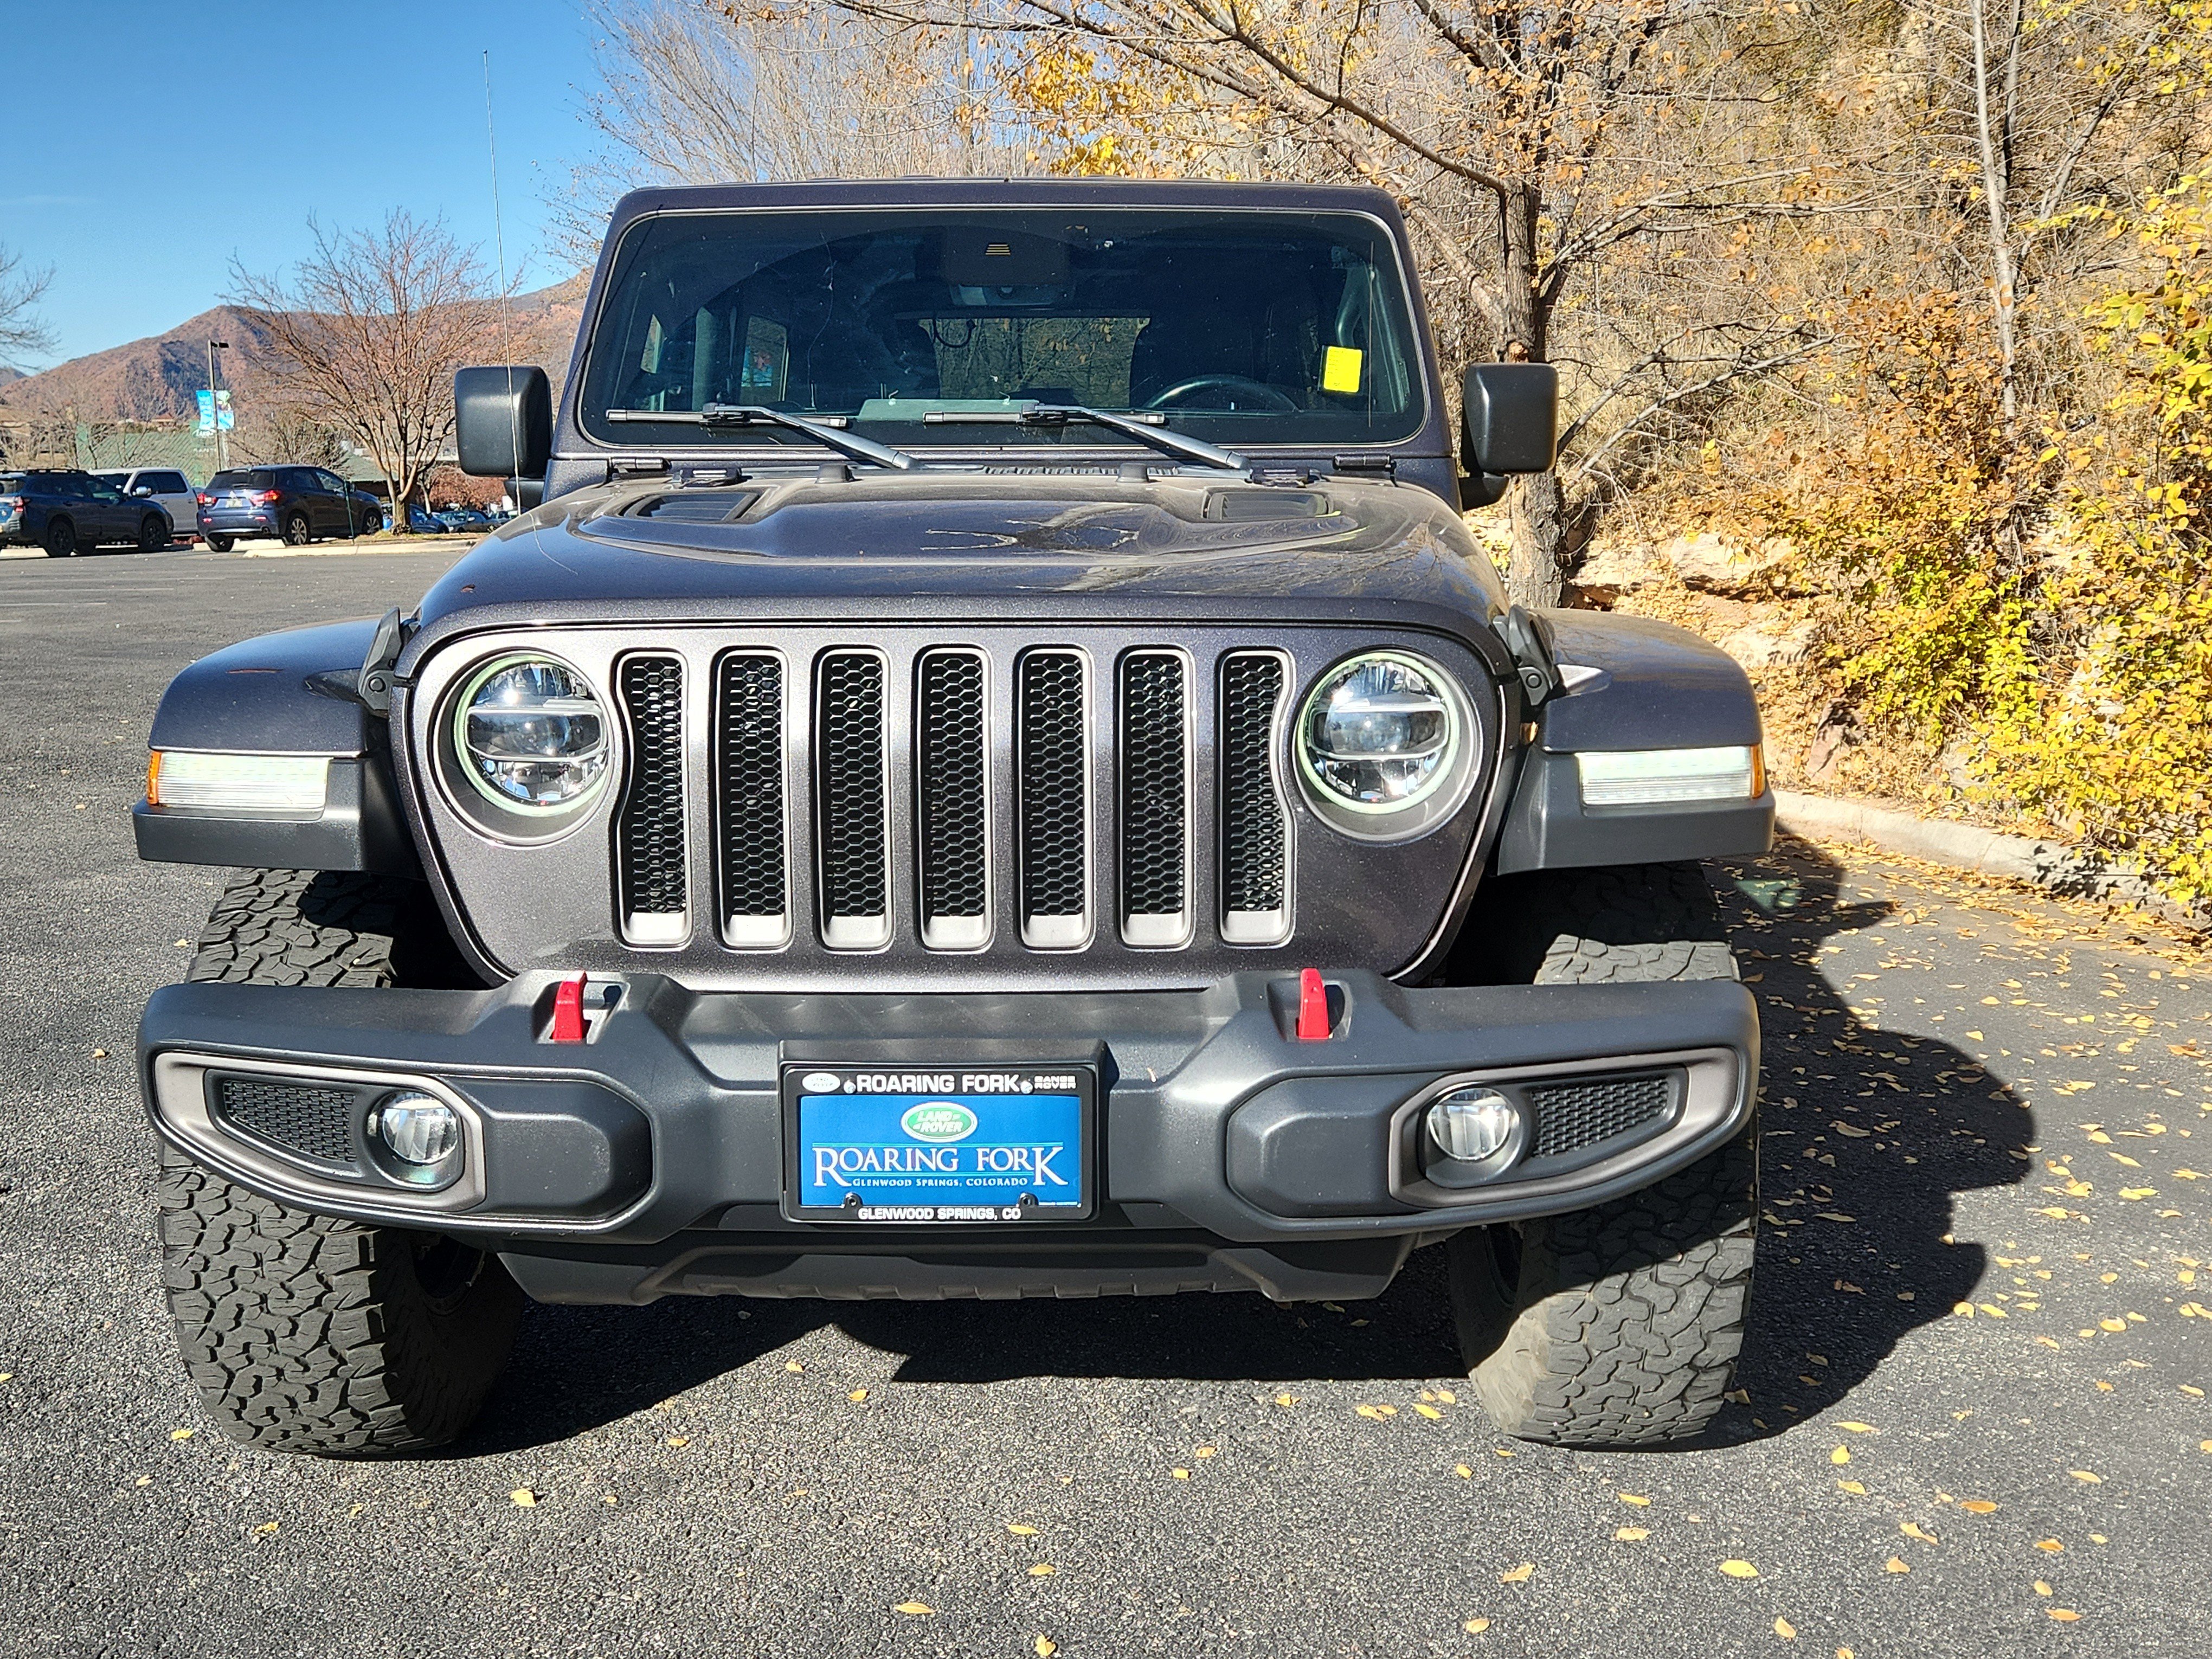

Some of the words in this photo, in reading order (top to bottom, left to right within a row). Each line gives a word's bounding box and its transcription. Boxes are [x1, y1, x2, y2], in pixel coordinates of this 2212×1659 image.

[857, 1075, 955, 1092] ROARING
[962, 1075, 1019, 1092] FORK
[920, 1121, 963, 1133] ROVER
[812, 1148, 959, 1186] ROARING
[976, 1147, 1068, 1186] FORK
[853, 1178, 912, 1187] GLENWOOD
[916, 1178, 962, 1187] SPRINGS,
[966, 1178, 1028, 1186] COLORADO
[858, 1208, 934, 1219] GLENWOOD
[937, 1208, 998, 1220] SPRINGS,
[1002, 1208, 1021, 1219] CO
